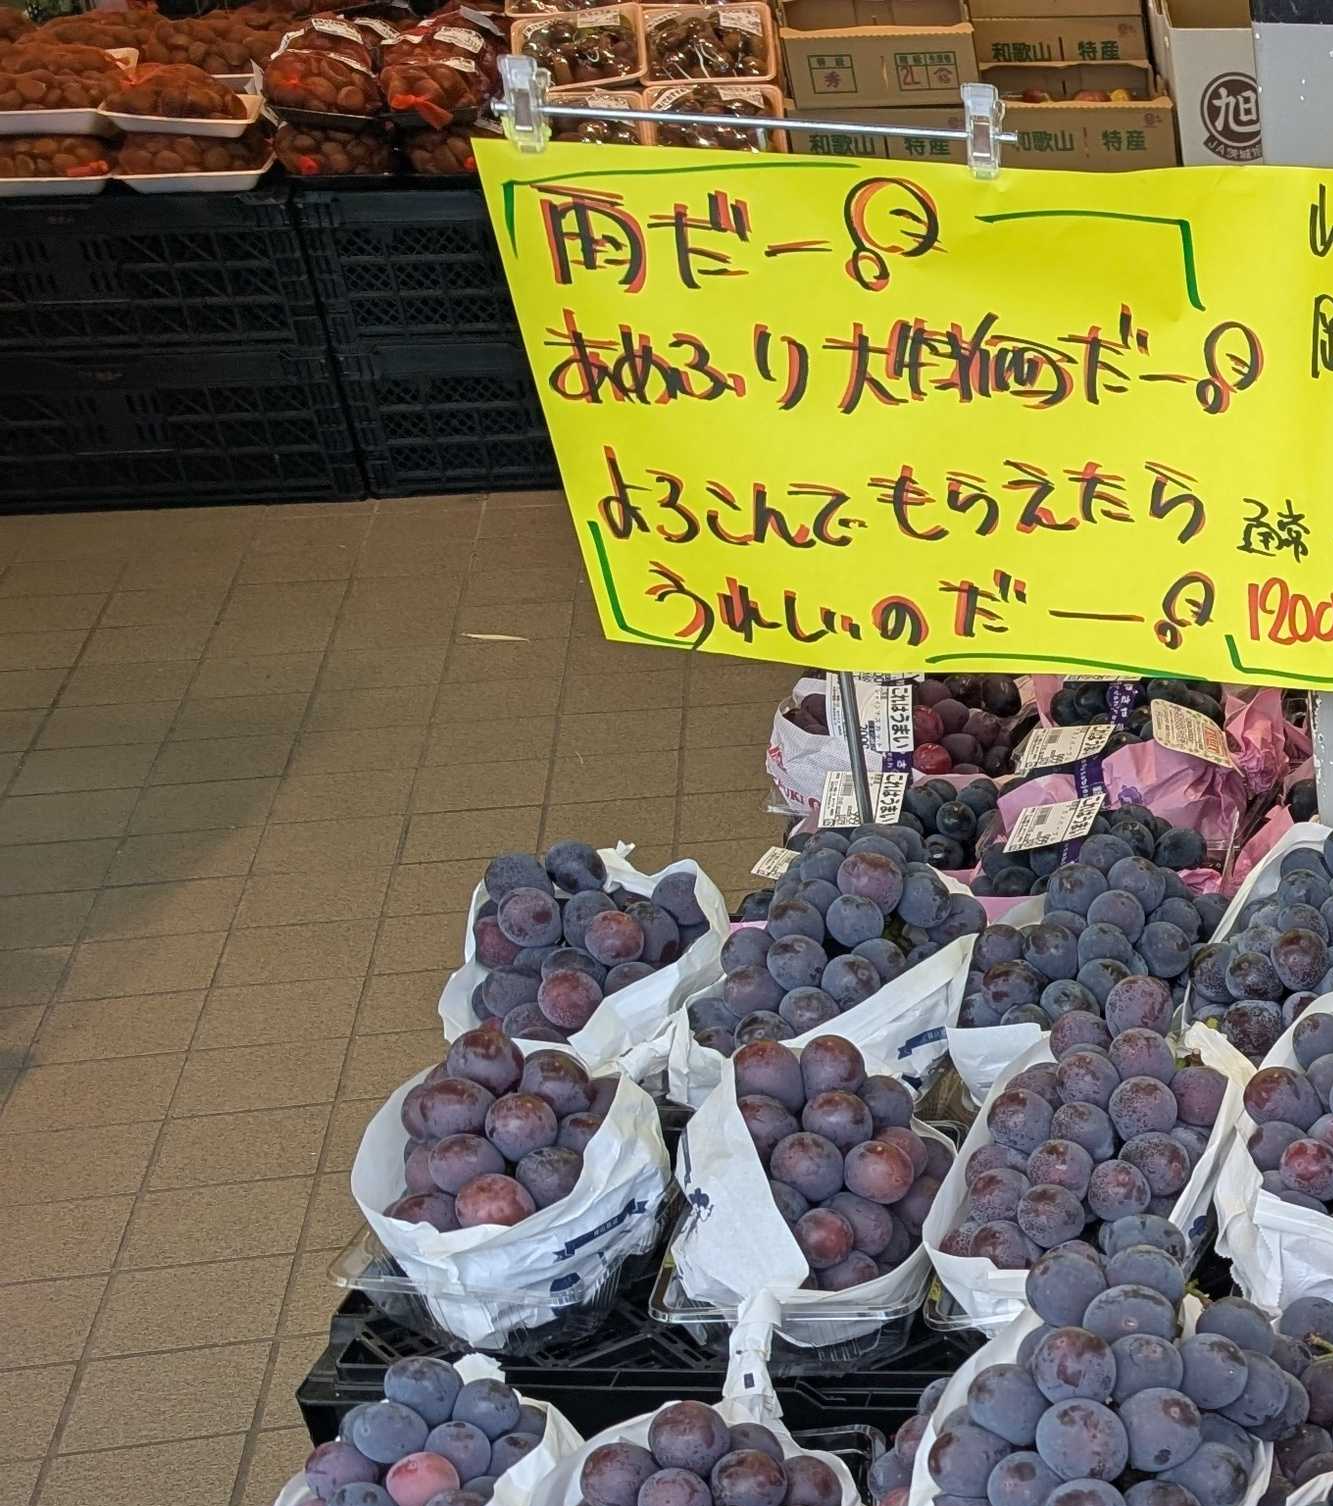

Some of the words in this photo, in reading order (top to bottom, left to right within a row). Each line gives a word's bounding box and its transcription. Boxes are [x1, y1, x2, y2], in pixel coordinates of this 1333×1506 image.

[991, 41, 1051, 62] 和歌山
[1077, 40, 1120, 60] 特産
[1211, 86, 1261, 133] 旭
[808, 132, 876, 157] 和歌山
[905, 132, 952, 157] 特産
[1101, 130, 1146, 151] 特産
[600, 446, 1208, 547] よろこんでもらえたら
[1236, 500, 1311, 563] 通常
